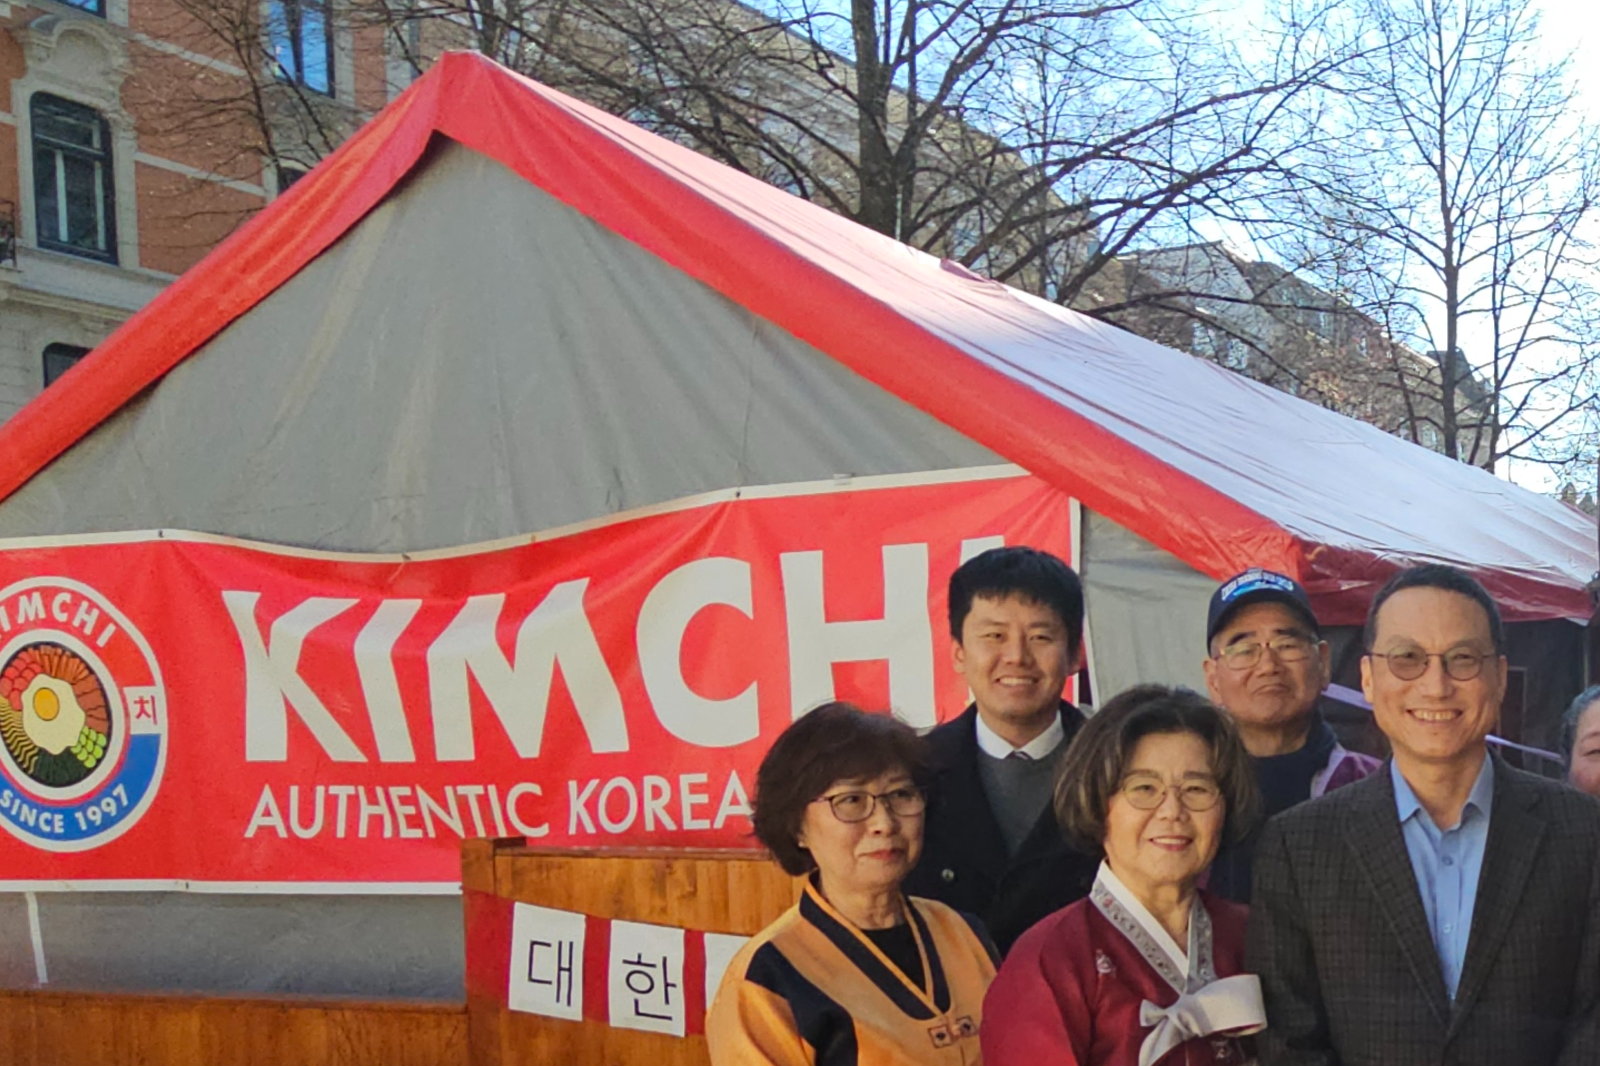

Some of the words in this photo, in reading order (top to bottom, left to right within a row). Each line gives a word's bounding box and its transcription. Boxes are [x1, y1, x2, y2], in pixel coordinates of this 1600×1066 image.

[0, 591, 116, 647] IMCHI
[221, 535, 1004, 761] KIMCH
[134, 695, 158, 726] 치
[1, 789, 65, 833] SINCE
[74, 783, 129, 831] 1997
[244, 782, 549, 838] AUTHENTIC
